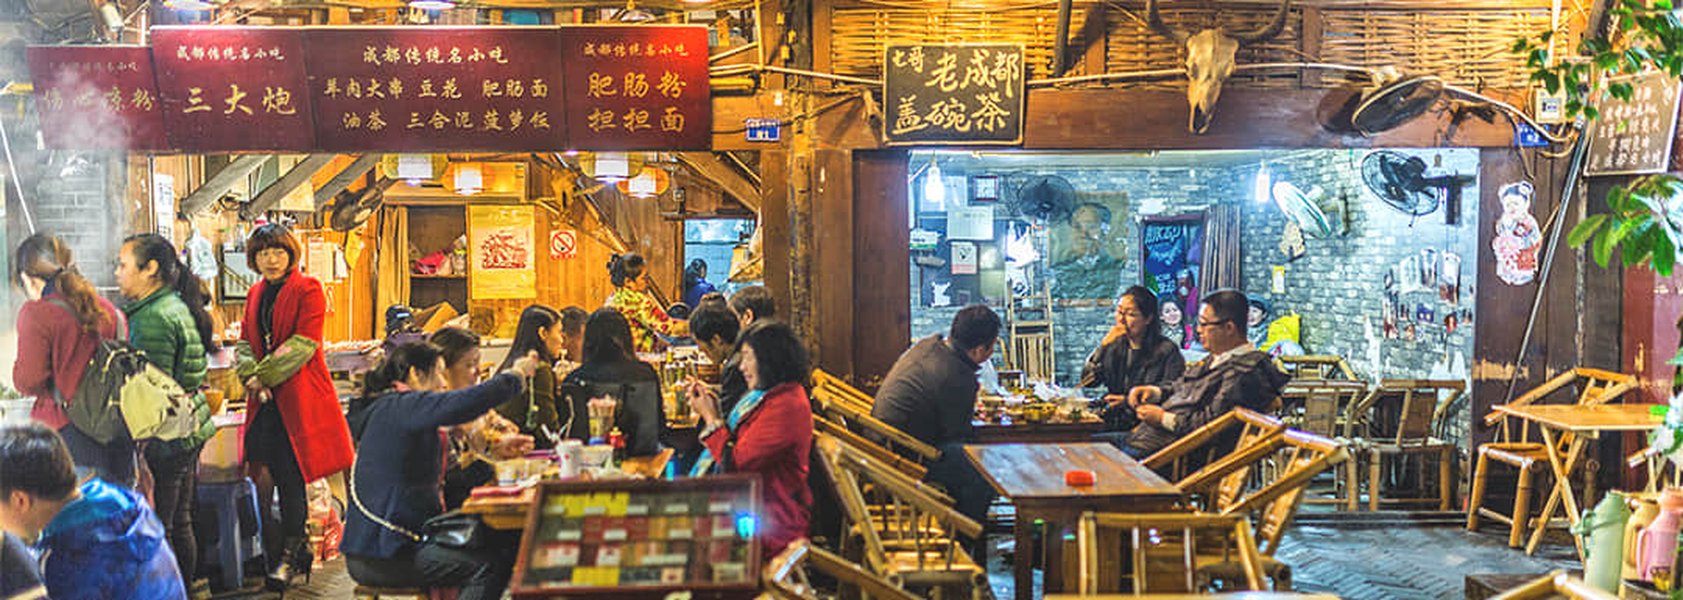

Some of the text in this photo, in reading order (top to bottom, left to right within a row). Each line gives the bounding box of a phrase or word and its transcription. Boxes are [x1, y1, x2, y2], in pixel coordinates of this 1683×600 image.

[176, 45, 285, 61] 成都传统名小吃
[363, 45, 509, 66] 成都传统名小吃
[583, 43, 690, 57] 成都传统名小吃
[586, 71, 687, 98] 肥肠粉
[925, 49, 1020, 98] 老成都
[324, 76, 548, 99] 羊肉大串 豆花 肥肠面
[182, 84, 297, 116] 三大炮
[343, 110, 387, 131] 油茶
[587, 108, 686, 133] 担担面
[891, 92, 1011, 135] 盖碗茶
